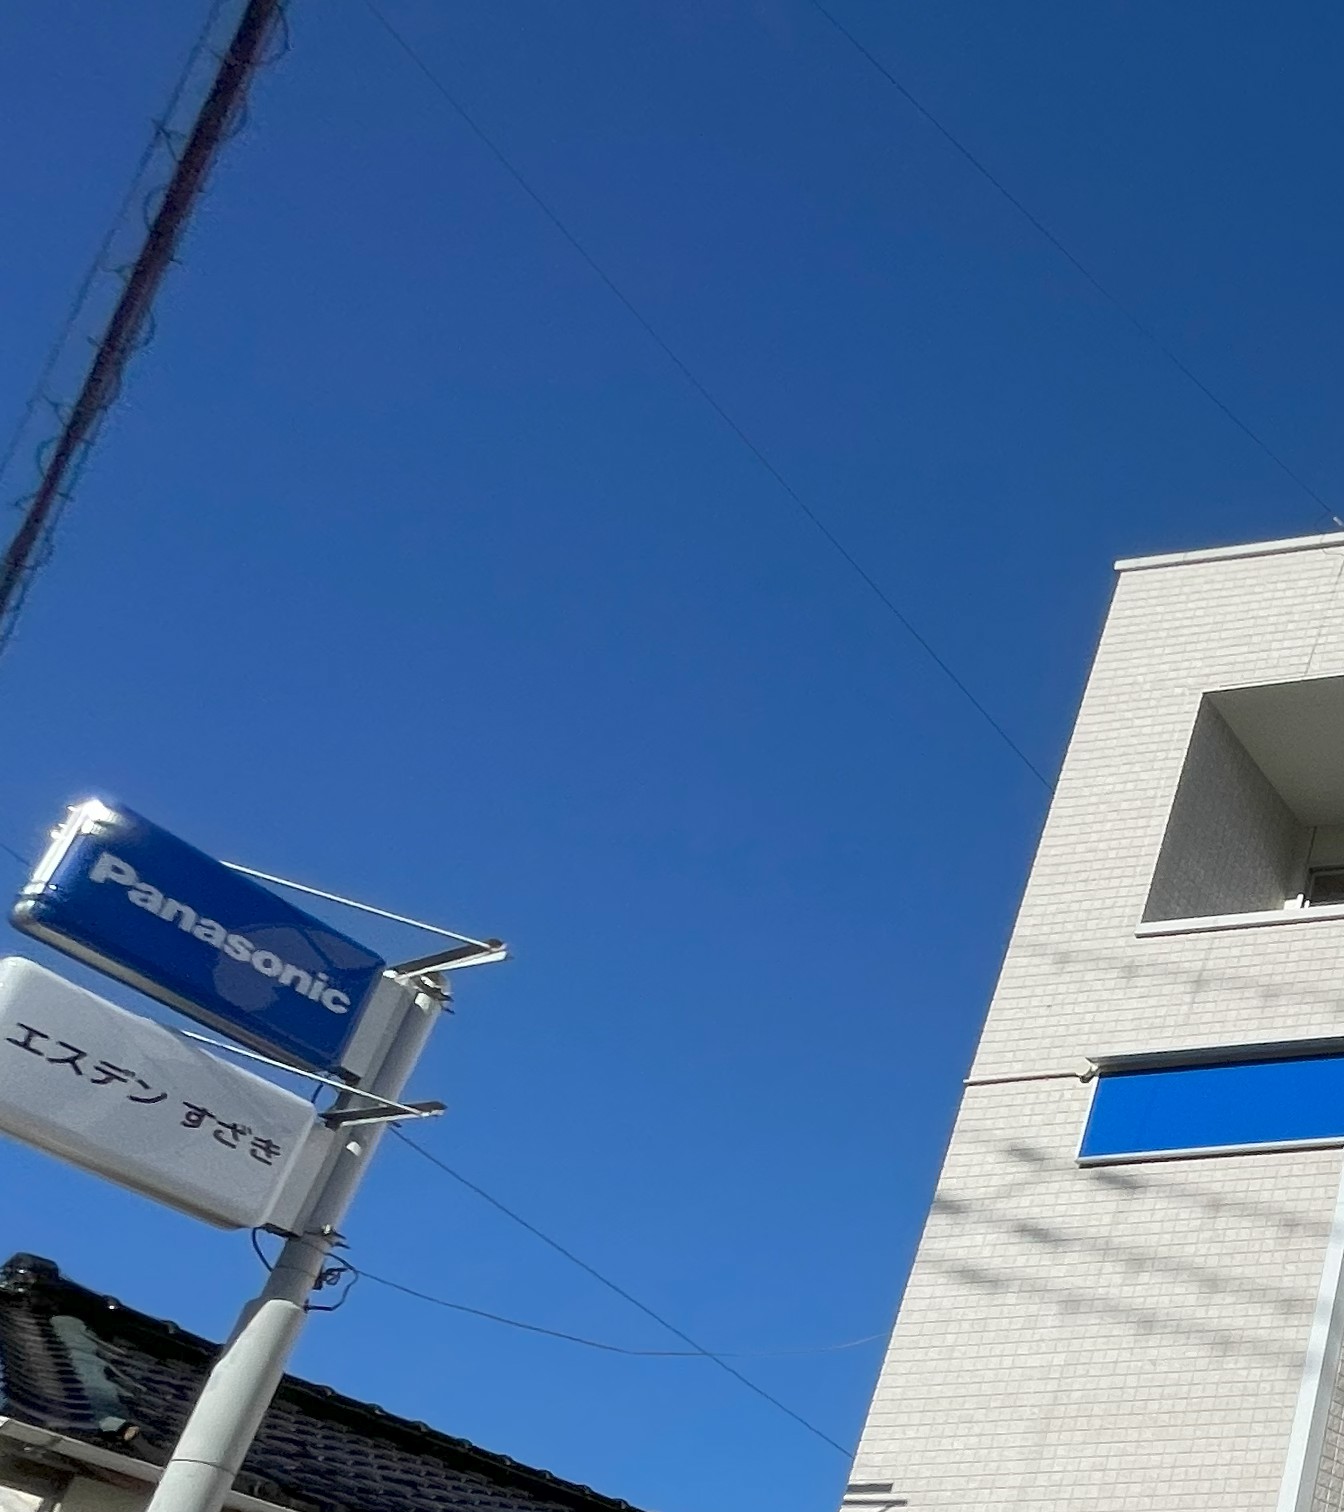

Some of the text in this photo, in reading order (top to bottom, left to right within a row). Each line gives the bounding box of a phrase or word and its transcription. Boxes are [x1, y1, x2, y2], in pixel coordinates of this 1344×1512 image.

[88, 852, 351, 1015] Panasonic
[6, 1021, 282, 1166] エスデン すざき
